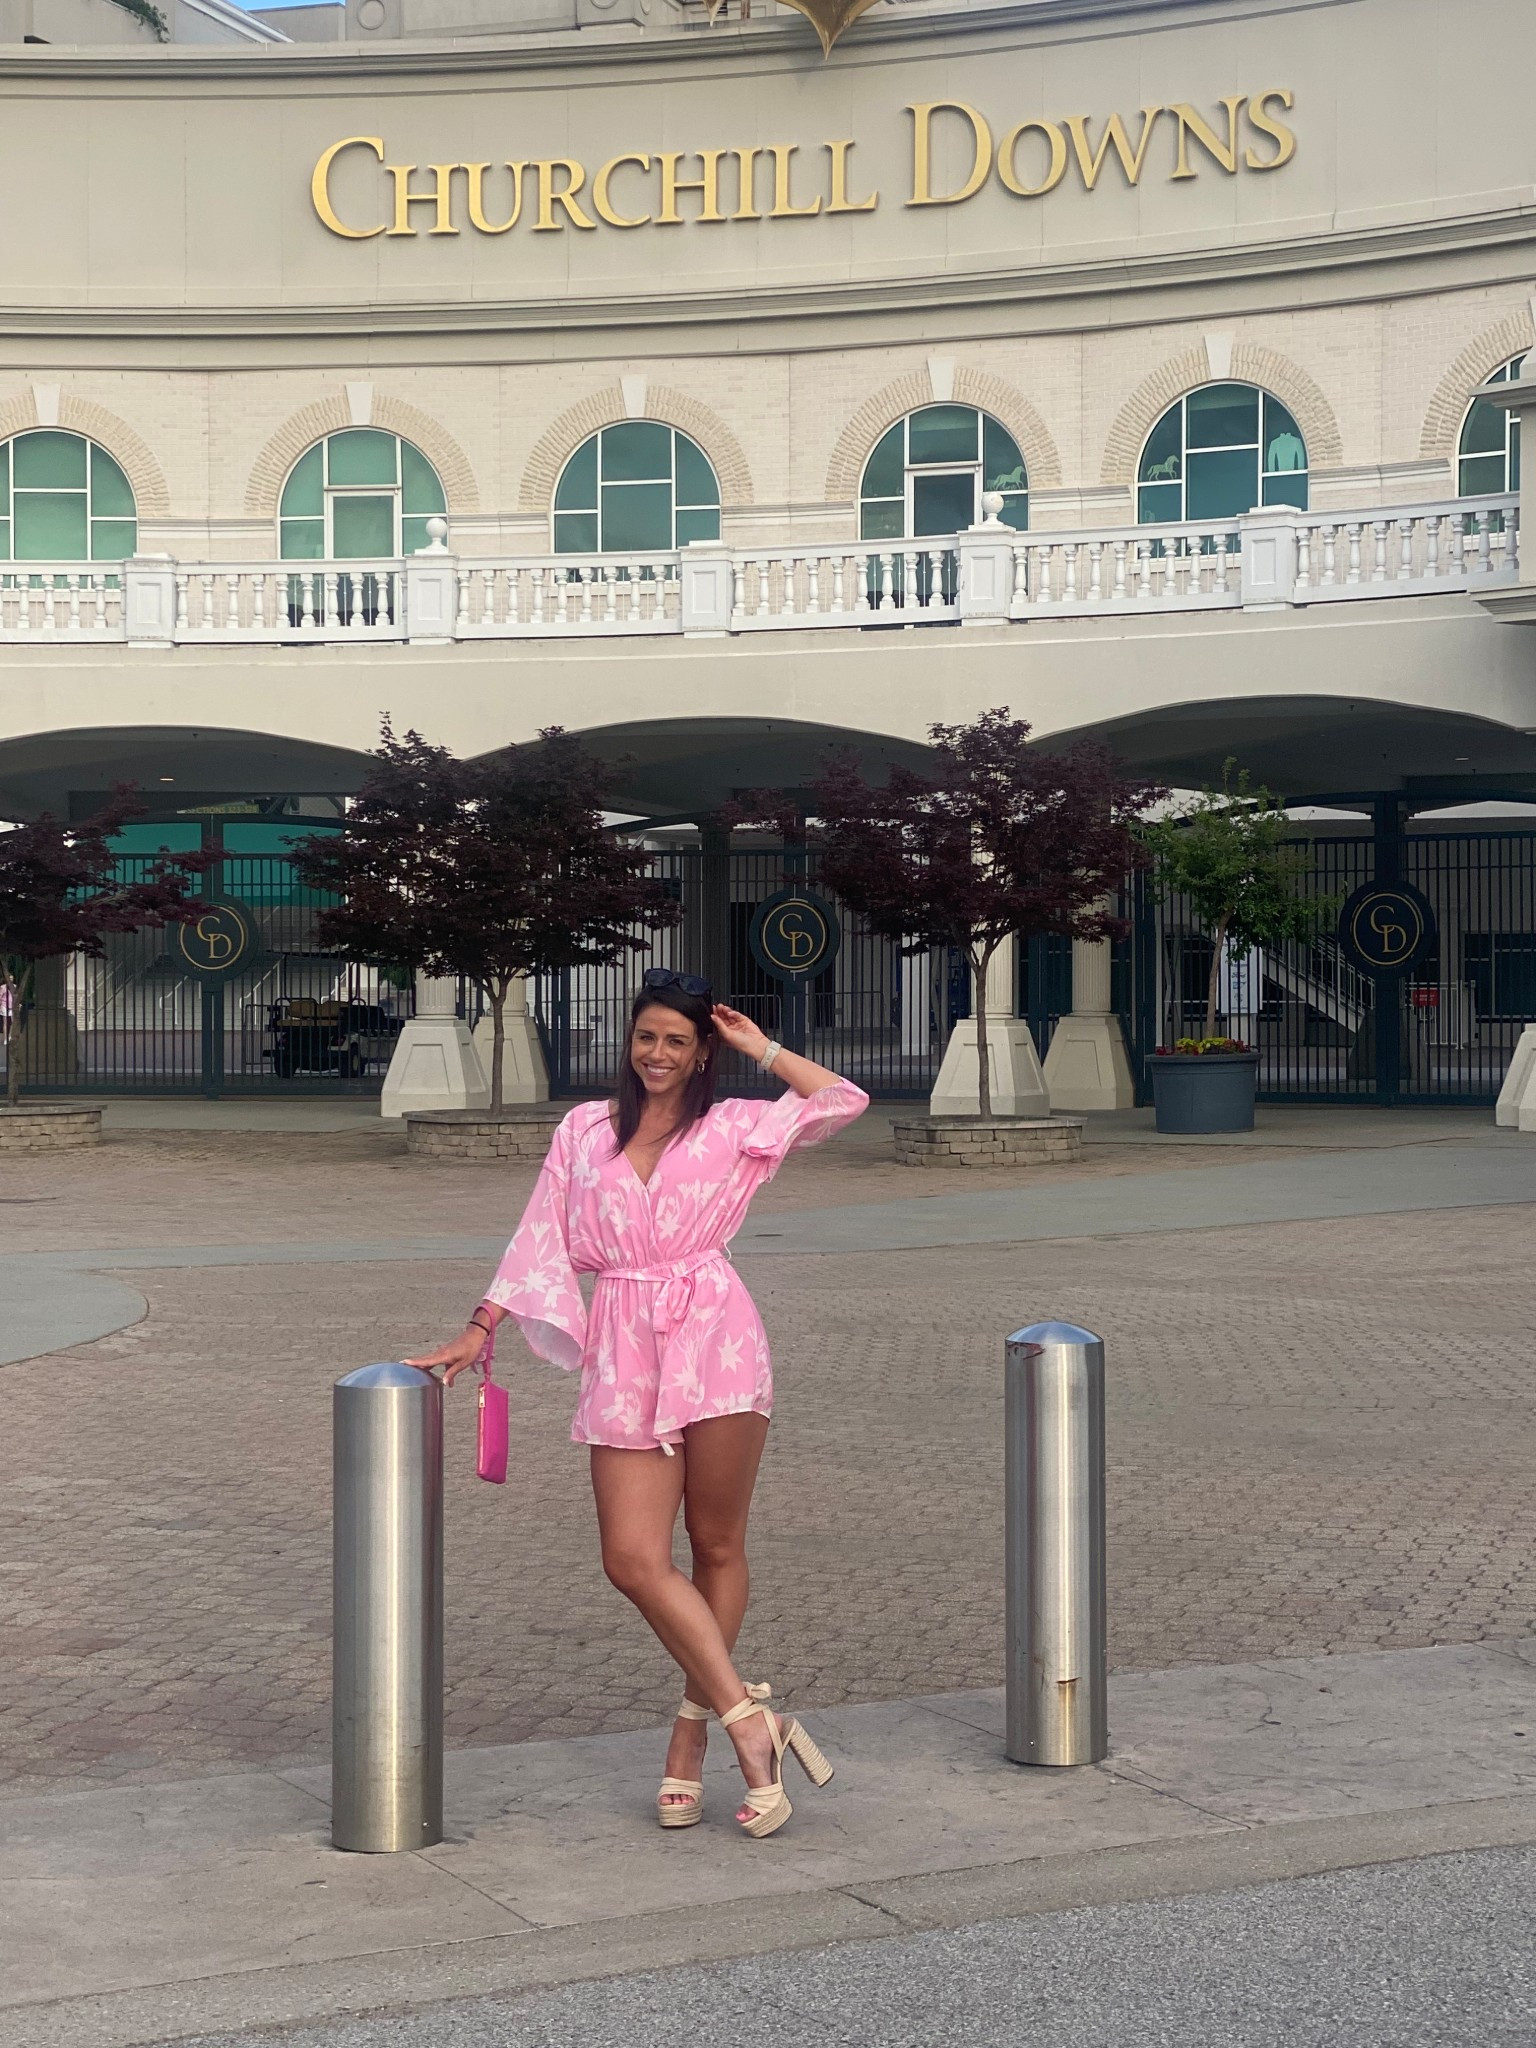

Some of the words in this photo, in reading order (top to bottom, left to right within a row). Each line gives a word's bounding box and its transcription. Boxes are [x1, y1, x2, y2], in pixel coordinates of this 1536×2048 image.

[311, 136, 878, 238] CHURCHILL
[904, 88, 1297, 207] DOWNS
[196, 915, 232, 959] CD
[779, 913, 814, 957] CD
[1370, 905, 1407, 953] CD
